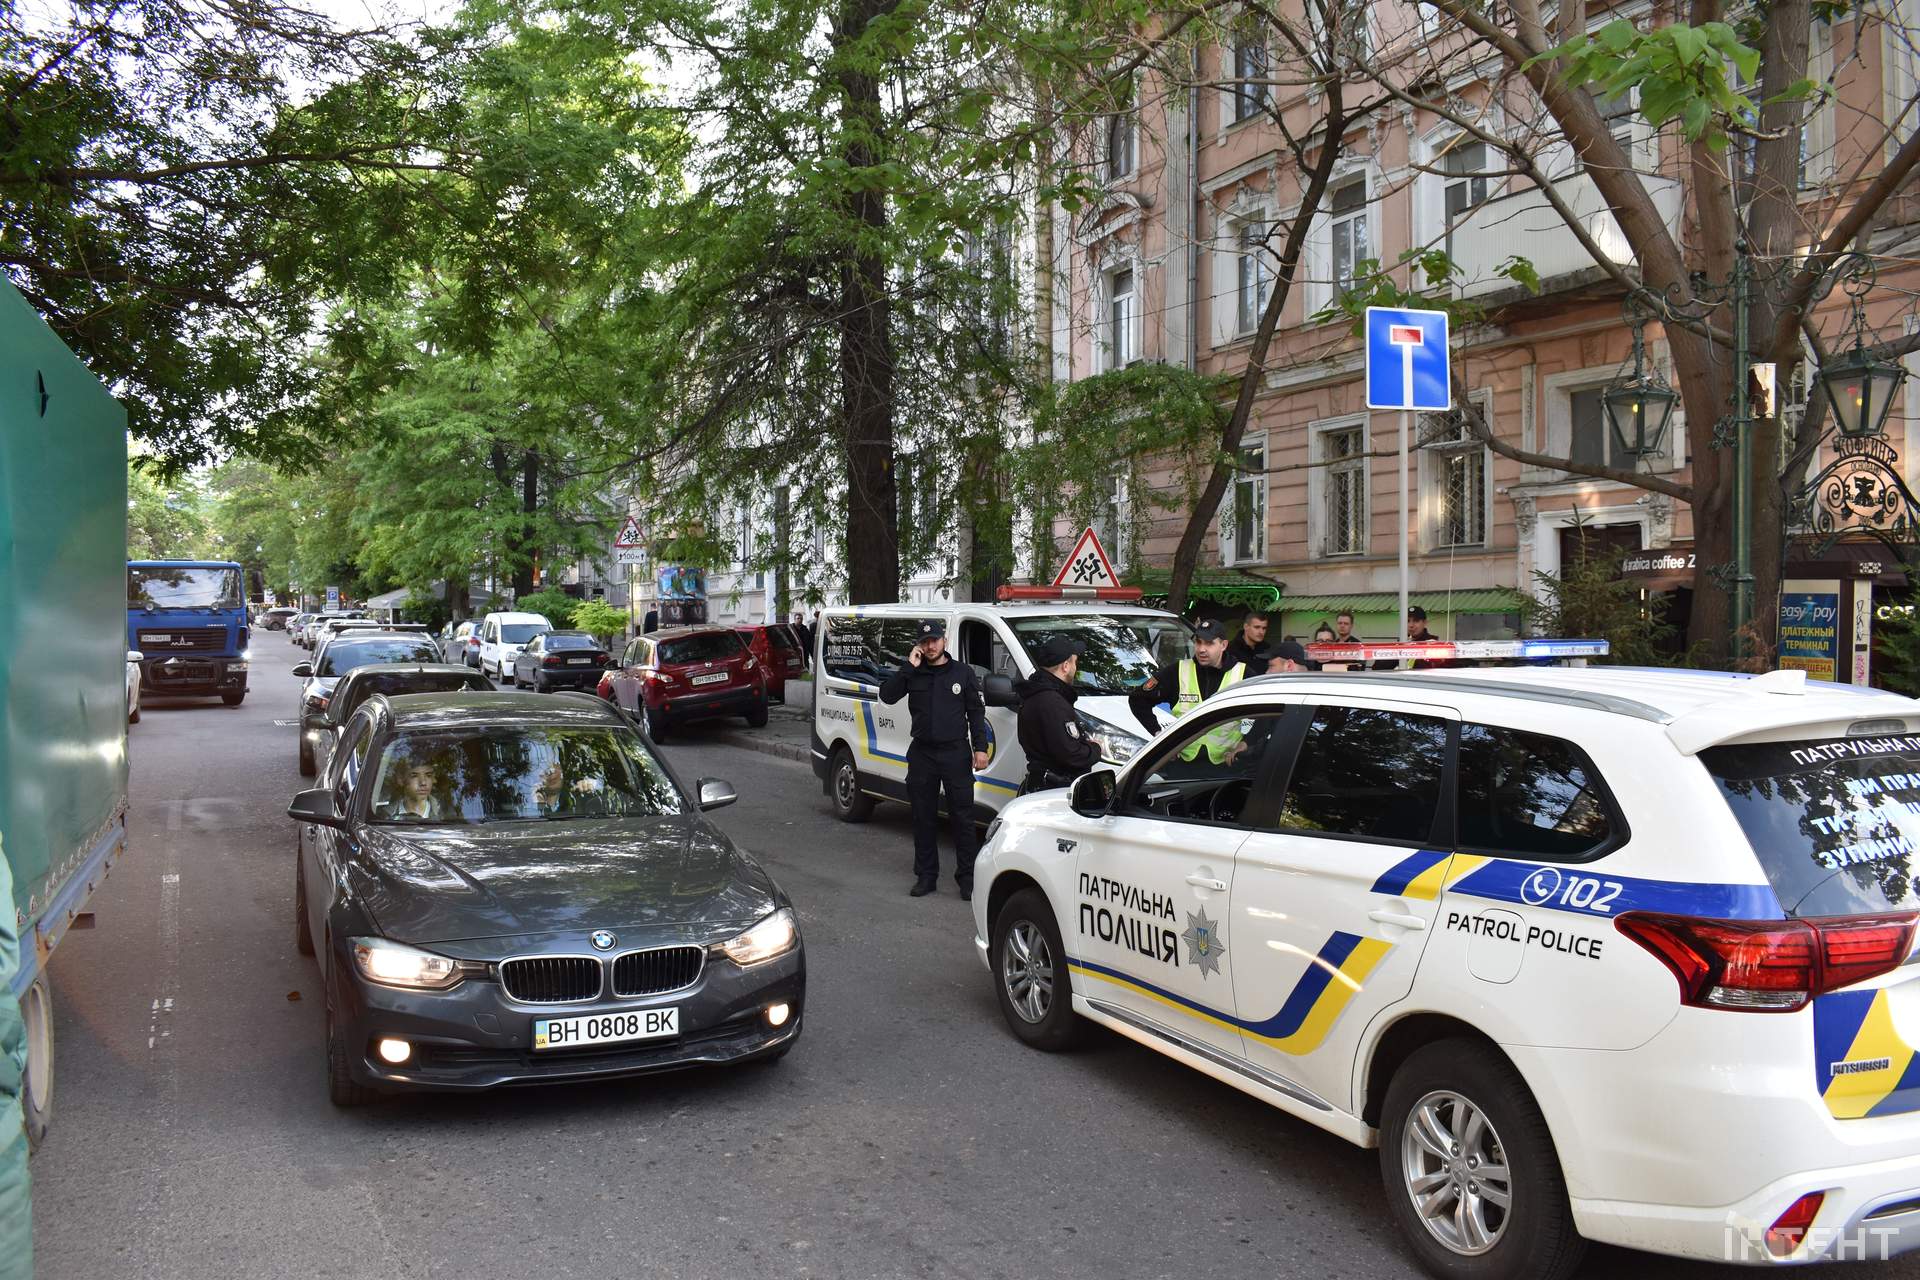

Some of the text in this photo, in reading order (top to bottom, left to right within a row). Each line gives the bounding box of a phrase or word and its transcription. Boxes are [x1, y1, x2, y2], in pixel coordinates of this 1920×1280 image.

[1652, 555, 1685, 570] coffee
[1781, 606, 1836, 622] easy pay
[1781, 626, 1834, 638] ПЛАТЕЖНЫЙ
[1785, 640, 1829, 651] ТЕРМИНАЛ
[879, 717, 895, 730] ВАРТА
[1790, 738, 1908, 765] ПАТРУЛЬНА
[1079, 872, 1176, 922] ПАТРУЛЬНА
[1560, 876, 1624, 912] 102
[1080, 903, 1180, 967] ПОЛІЦІЯ
[1447, 912, 1603, 960] PATROL POLICE
[549, 1010, 674, 1043] BH 0808 BK
[1833, 1059, 1889, 1075] MITSUBISHI
